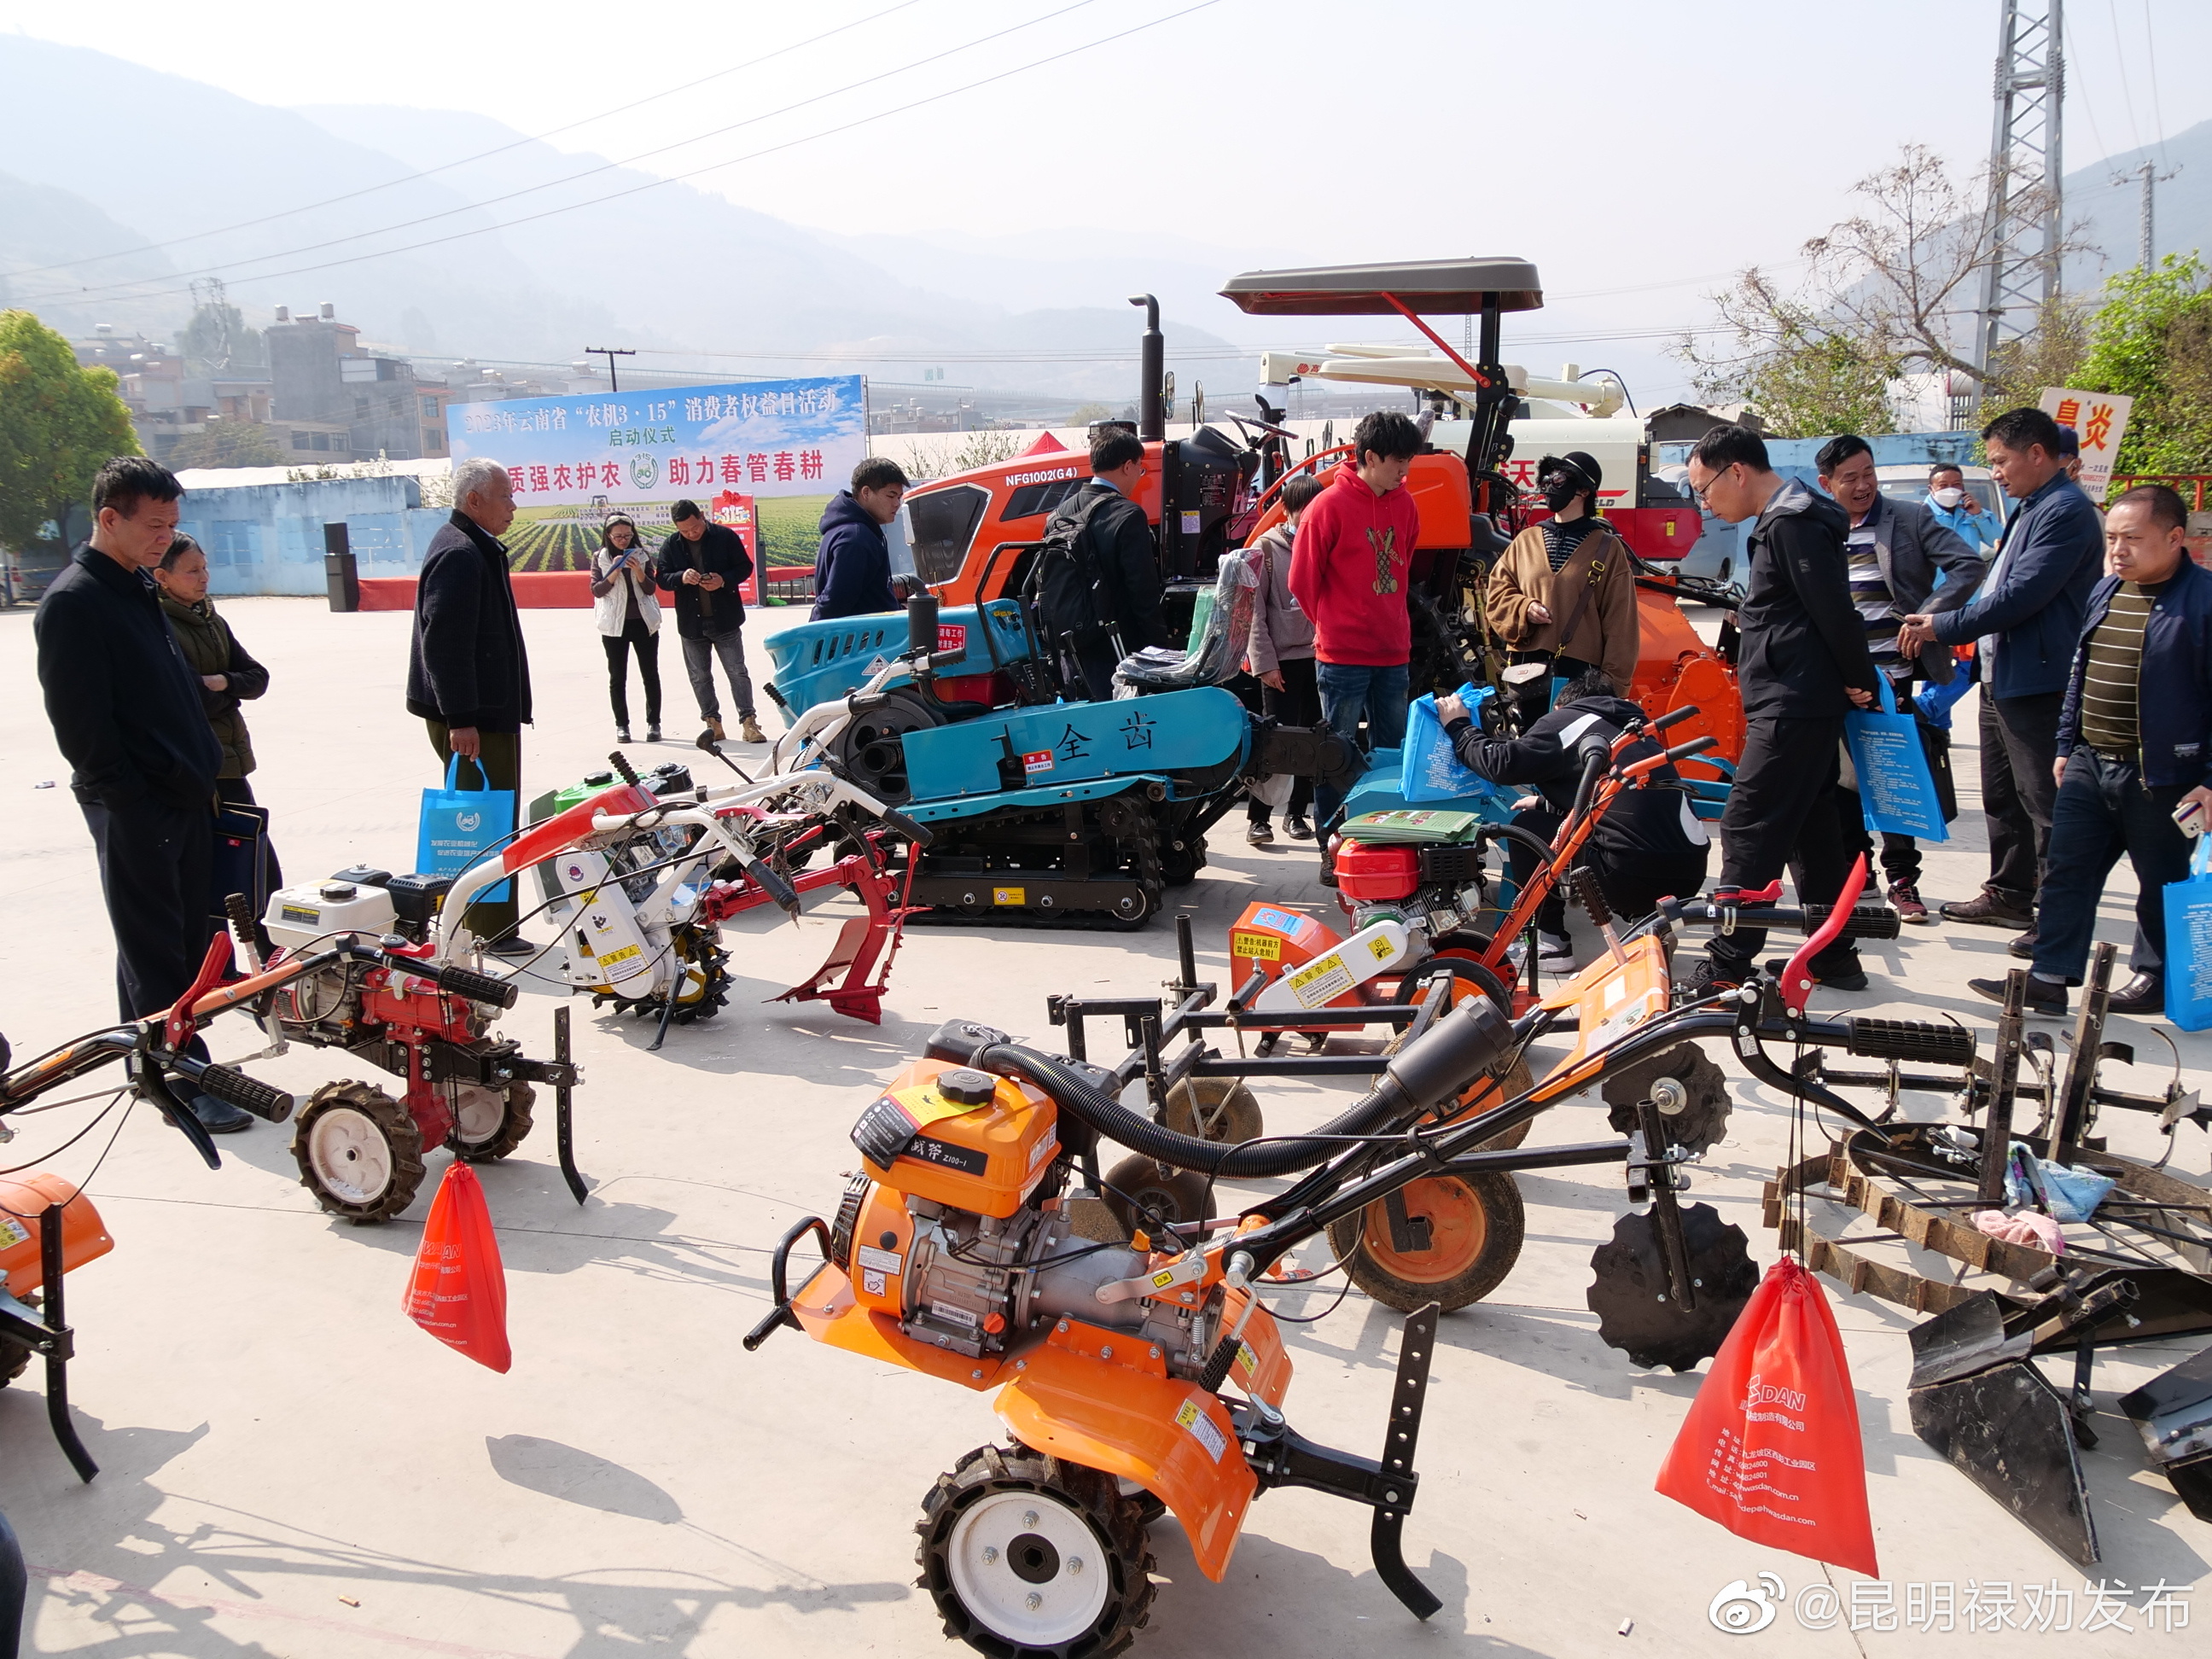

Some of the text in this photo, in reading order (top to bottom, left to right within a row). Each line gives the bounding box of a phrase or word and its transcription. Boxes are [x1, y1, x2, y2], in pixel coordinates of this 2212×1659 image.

[609, 425, 676, 447] 启动仪式
[669, 449, 824, 486] 助力春管春耕
